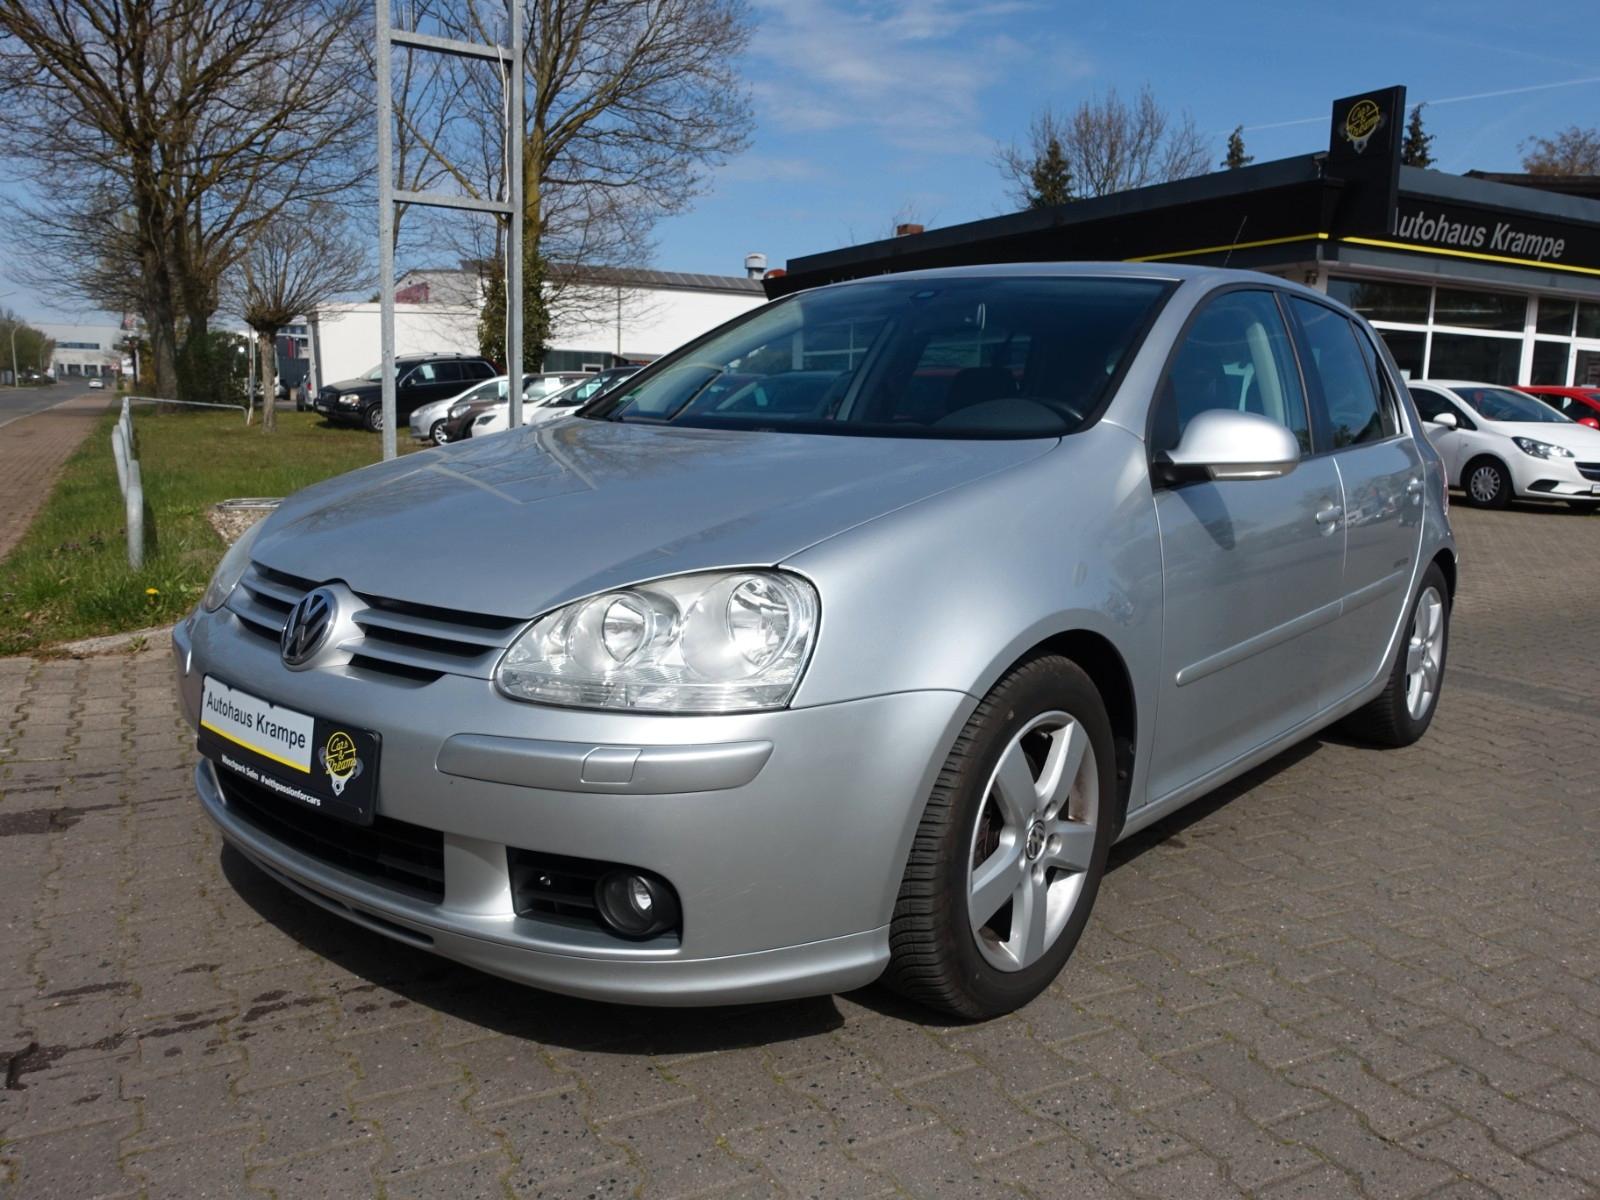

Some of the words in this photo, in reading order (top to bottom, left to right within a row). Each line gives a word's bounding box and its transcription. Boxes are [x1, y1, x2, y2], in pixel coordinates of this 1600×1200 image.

[1490, 222, 1565, 261] Krampe
[206, 691, 253, 728] Autohaus
[256, 712, 307, 750] Krampe
[331, 738, 348, 751] Cars
